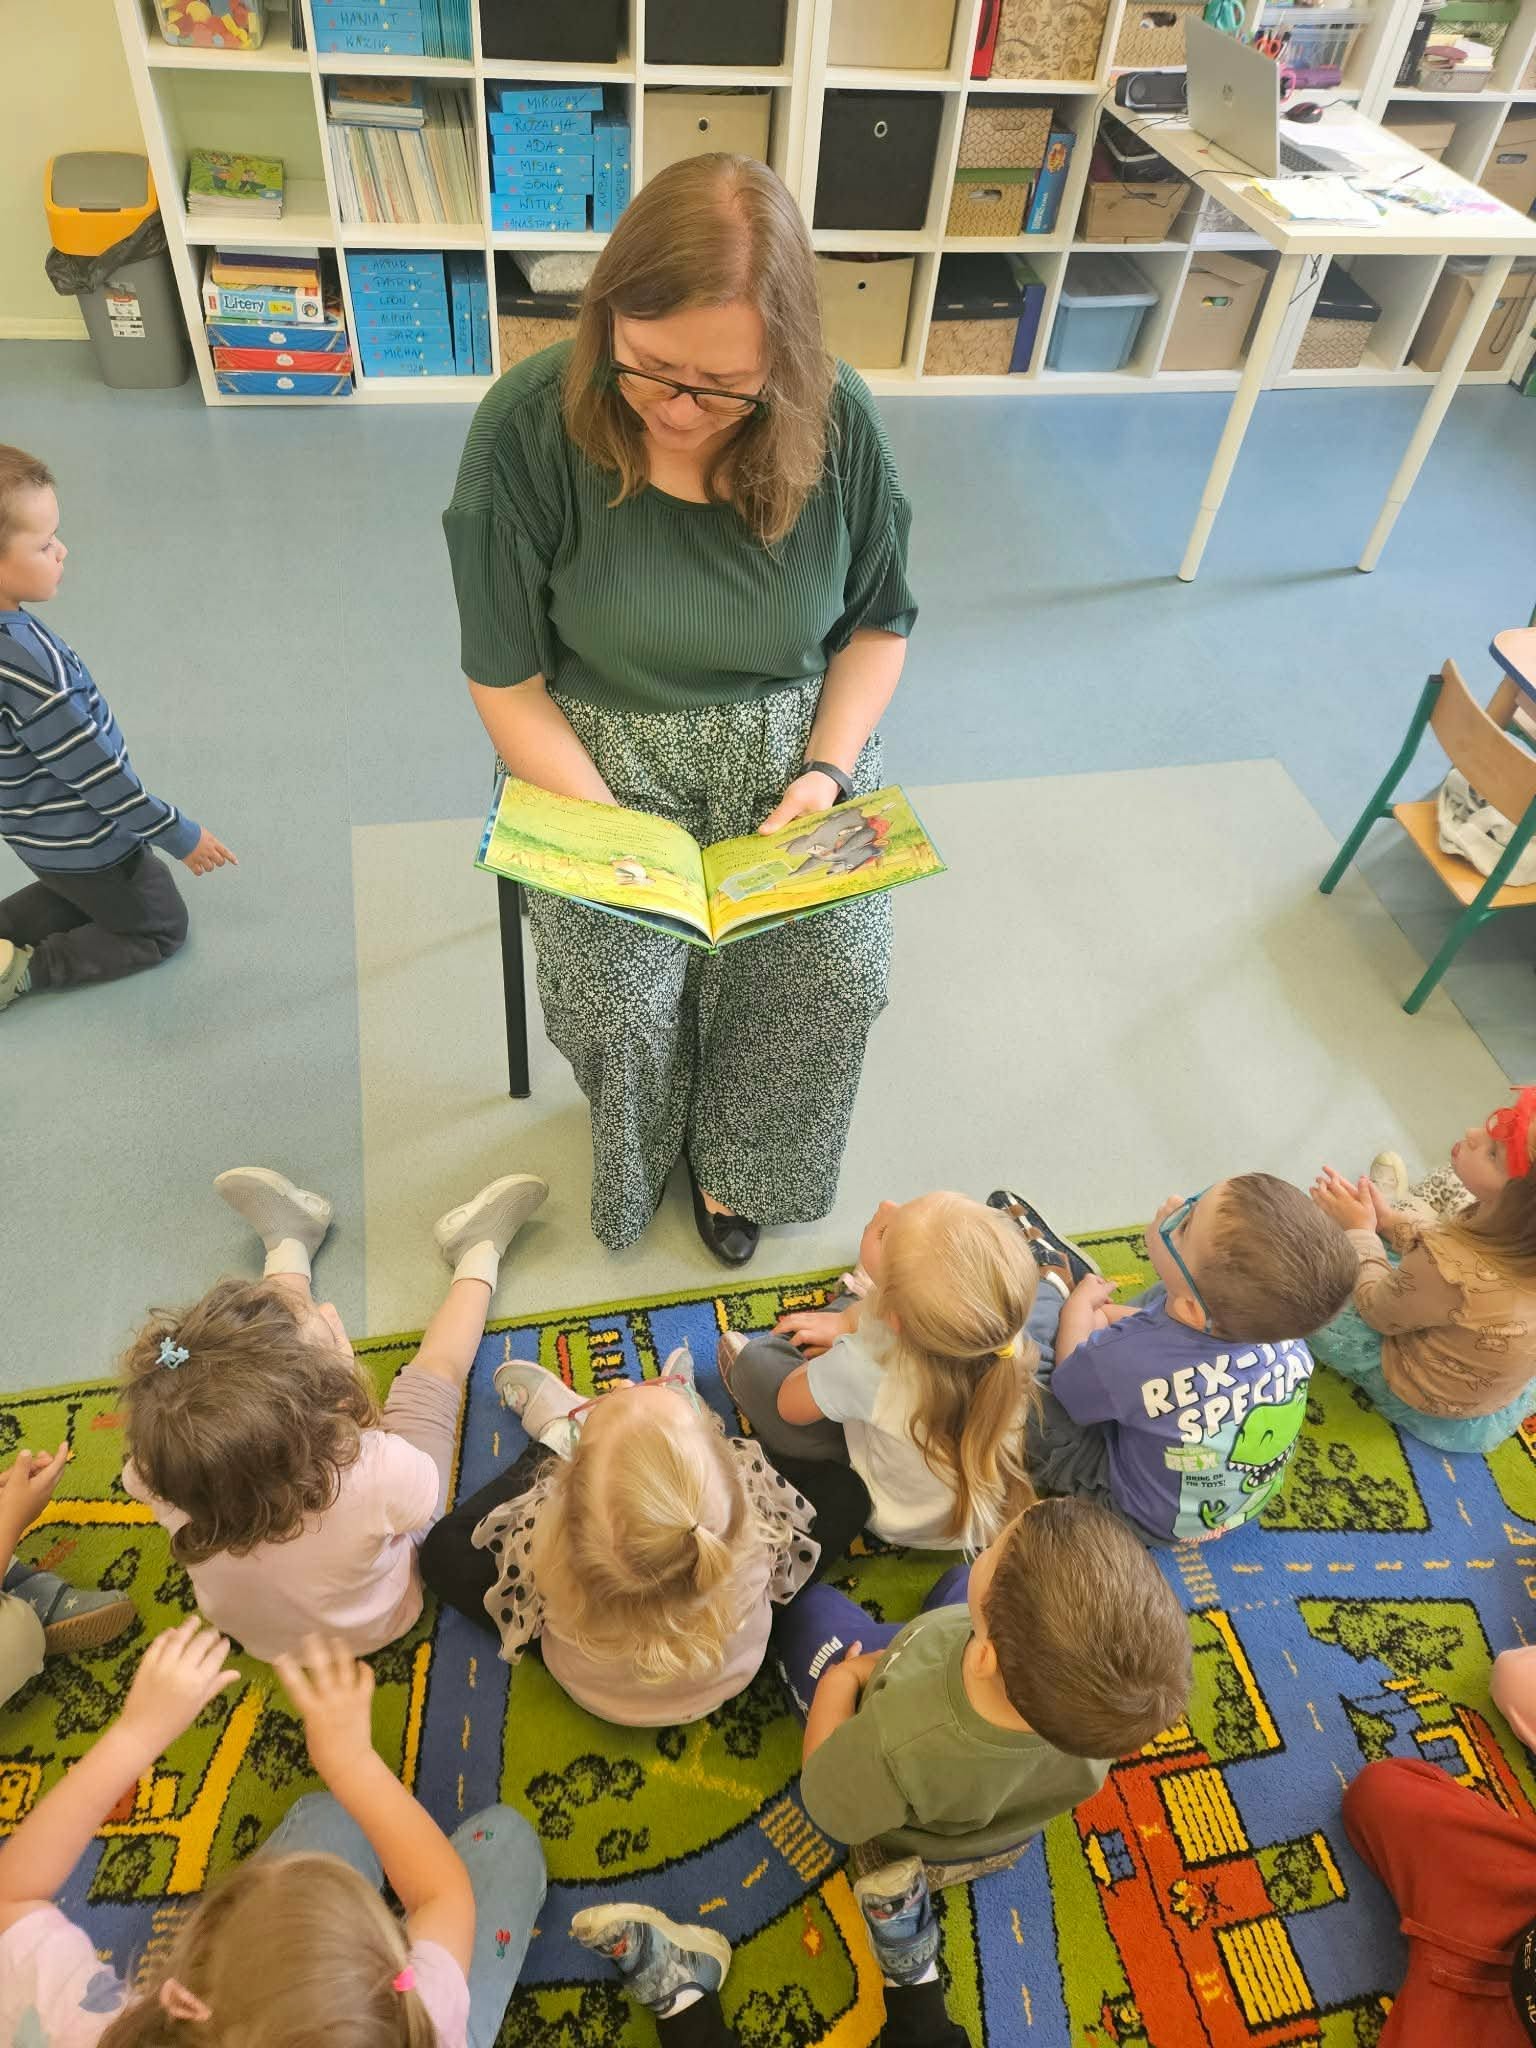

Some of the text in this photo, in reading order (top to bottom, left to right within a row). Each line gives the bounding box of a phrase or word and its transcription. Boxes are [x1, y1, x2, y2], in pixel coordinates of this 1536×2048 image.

[340, 11, 378, 26] HANIA
[525, 139, 559, 153] ADA
[224, 296, 264, 313] Litery
